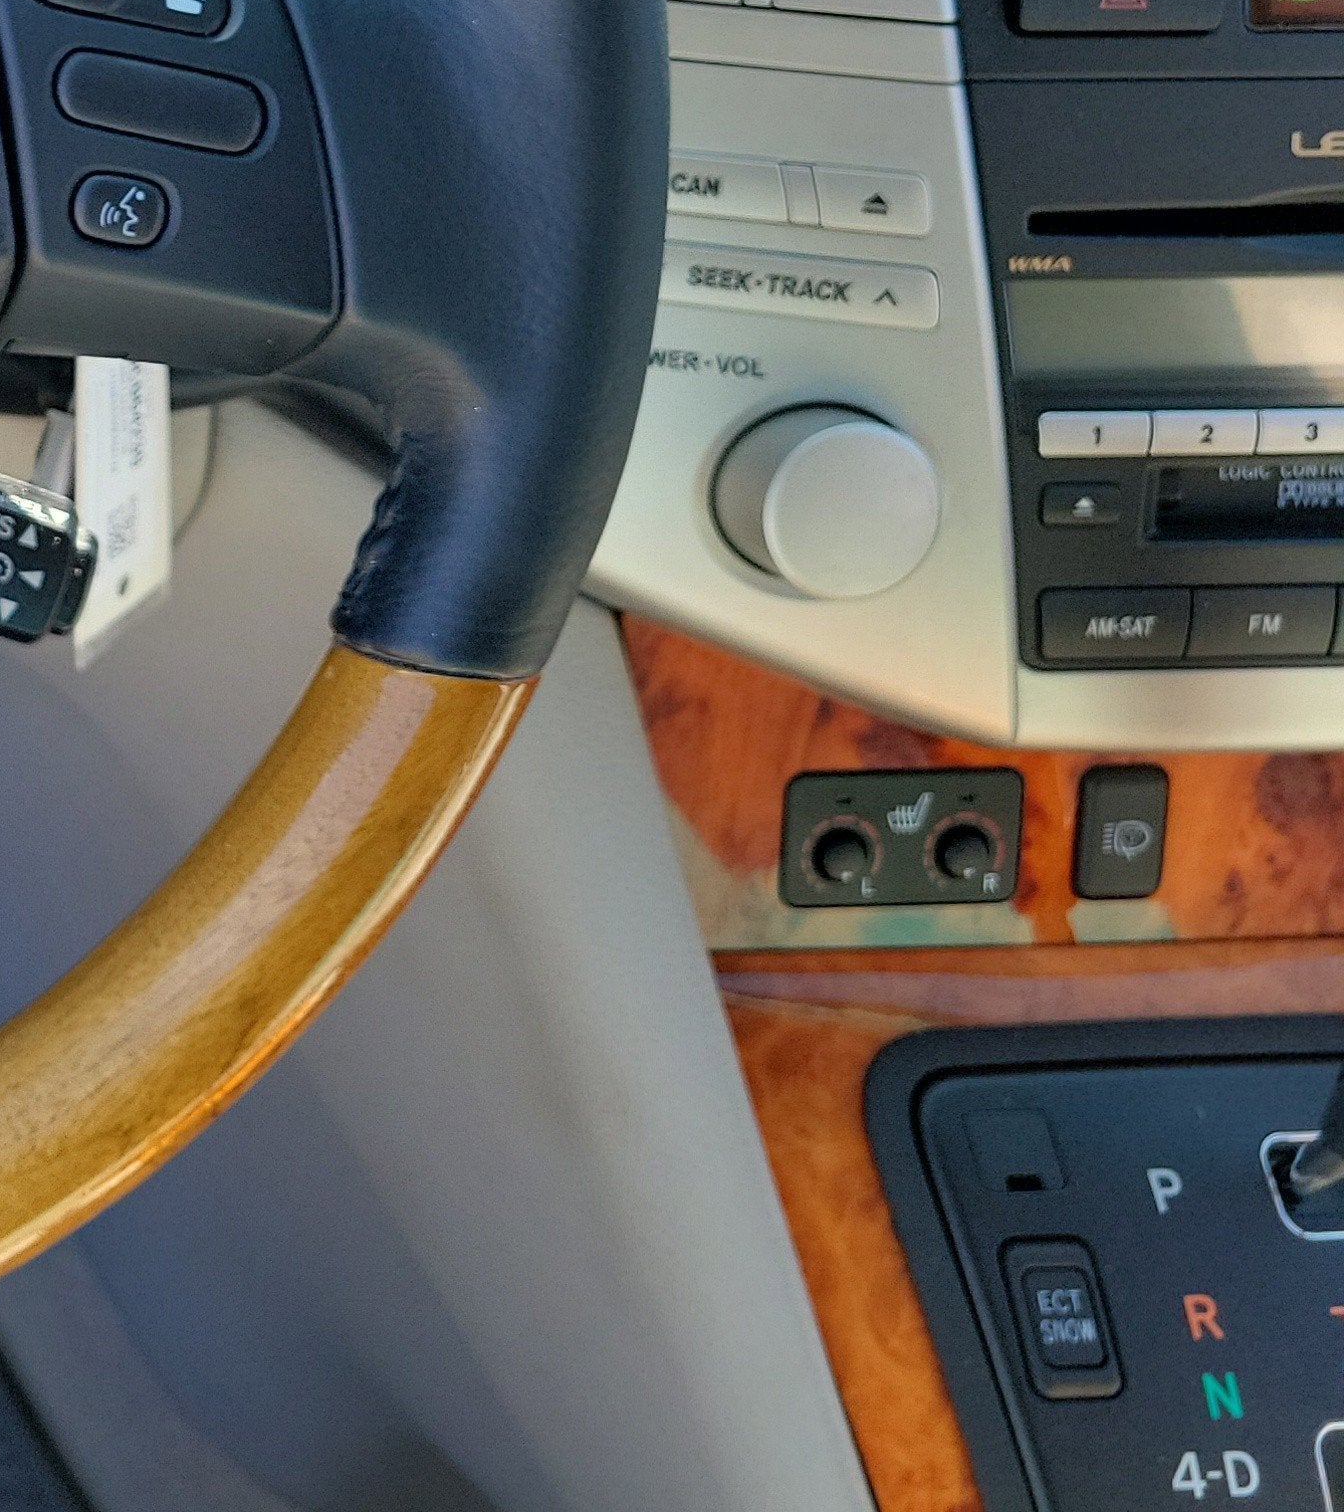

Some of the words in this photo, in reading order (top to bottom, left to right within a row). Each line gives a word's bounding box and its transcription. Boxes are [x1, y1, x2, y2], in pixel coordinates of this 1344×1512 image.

[1009, 254, 1072, 274] WMA
[1091, 425, 1103, 447] 1
[1200, 424, 1214, 444] 2
[1304, 421, 1319, 443] 3
[1247, 612, 1284, 637] FM
[860, 876, 877, 899] L
[982, 872, 1002, 894] R
[1146, 1166, 1184, 1216] P
[1036, 1288, 1084, 1316] ECT
[1183, 1293, 1226, 1342] R
[1039, 1317, 1099, 1346] SNOW
[1202, 1371, 1245, 1421] N
[1171, 1449, 1261, 1501] 4-D
